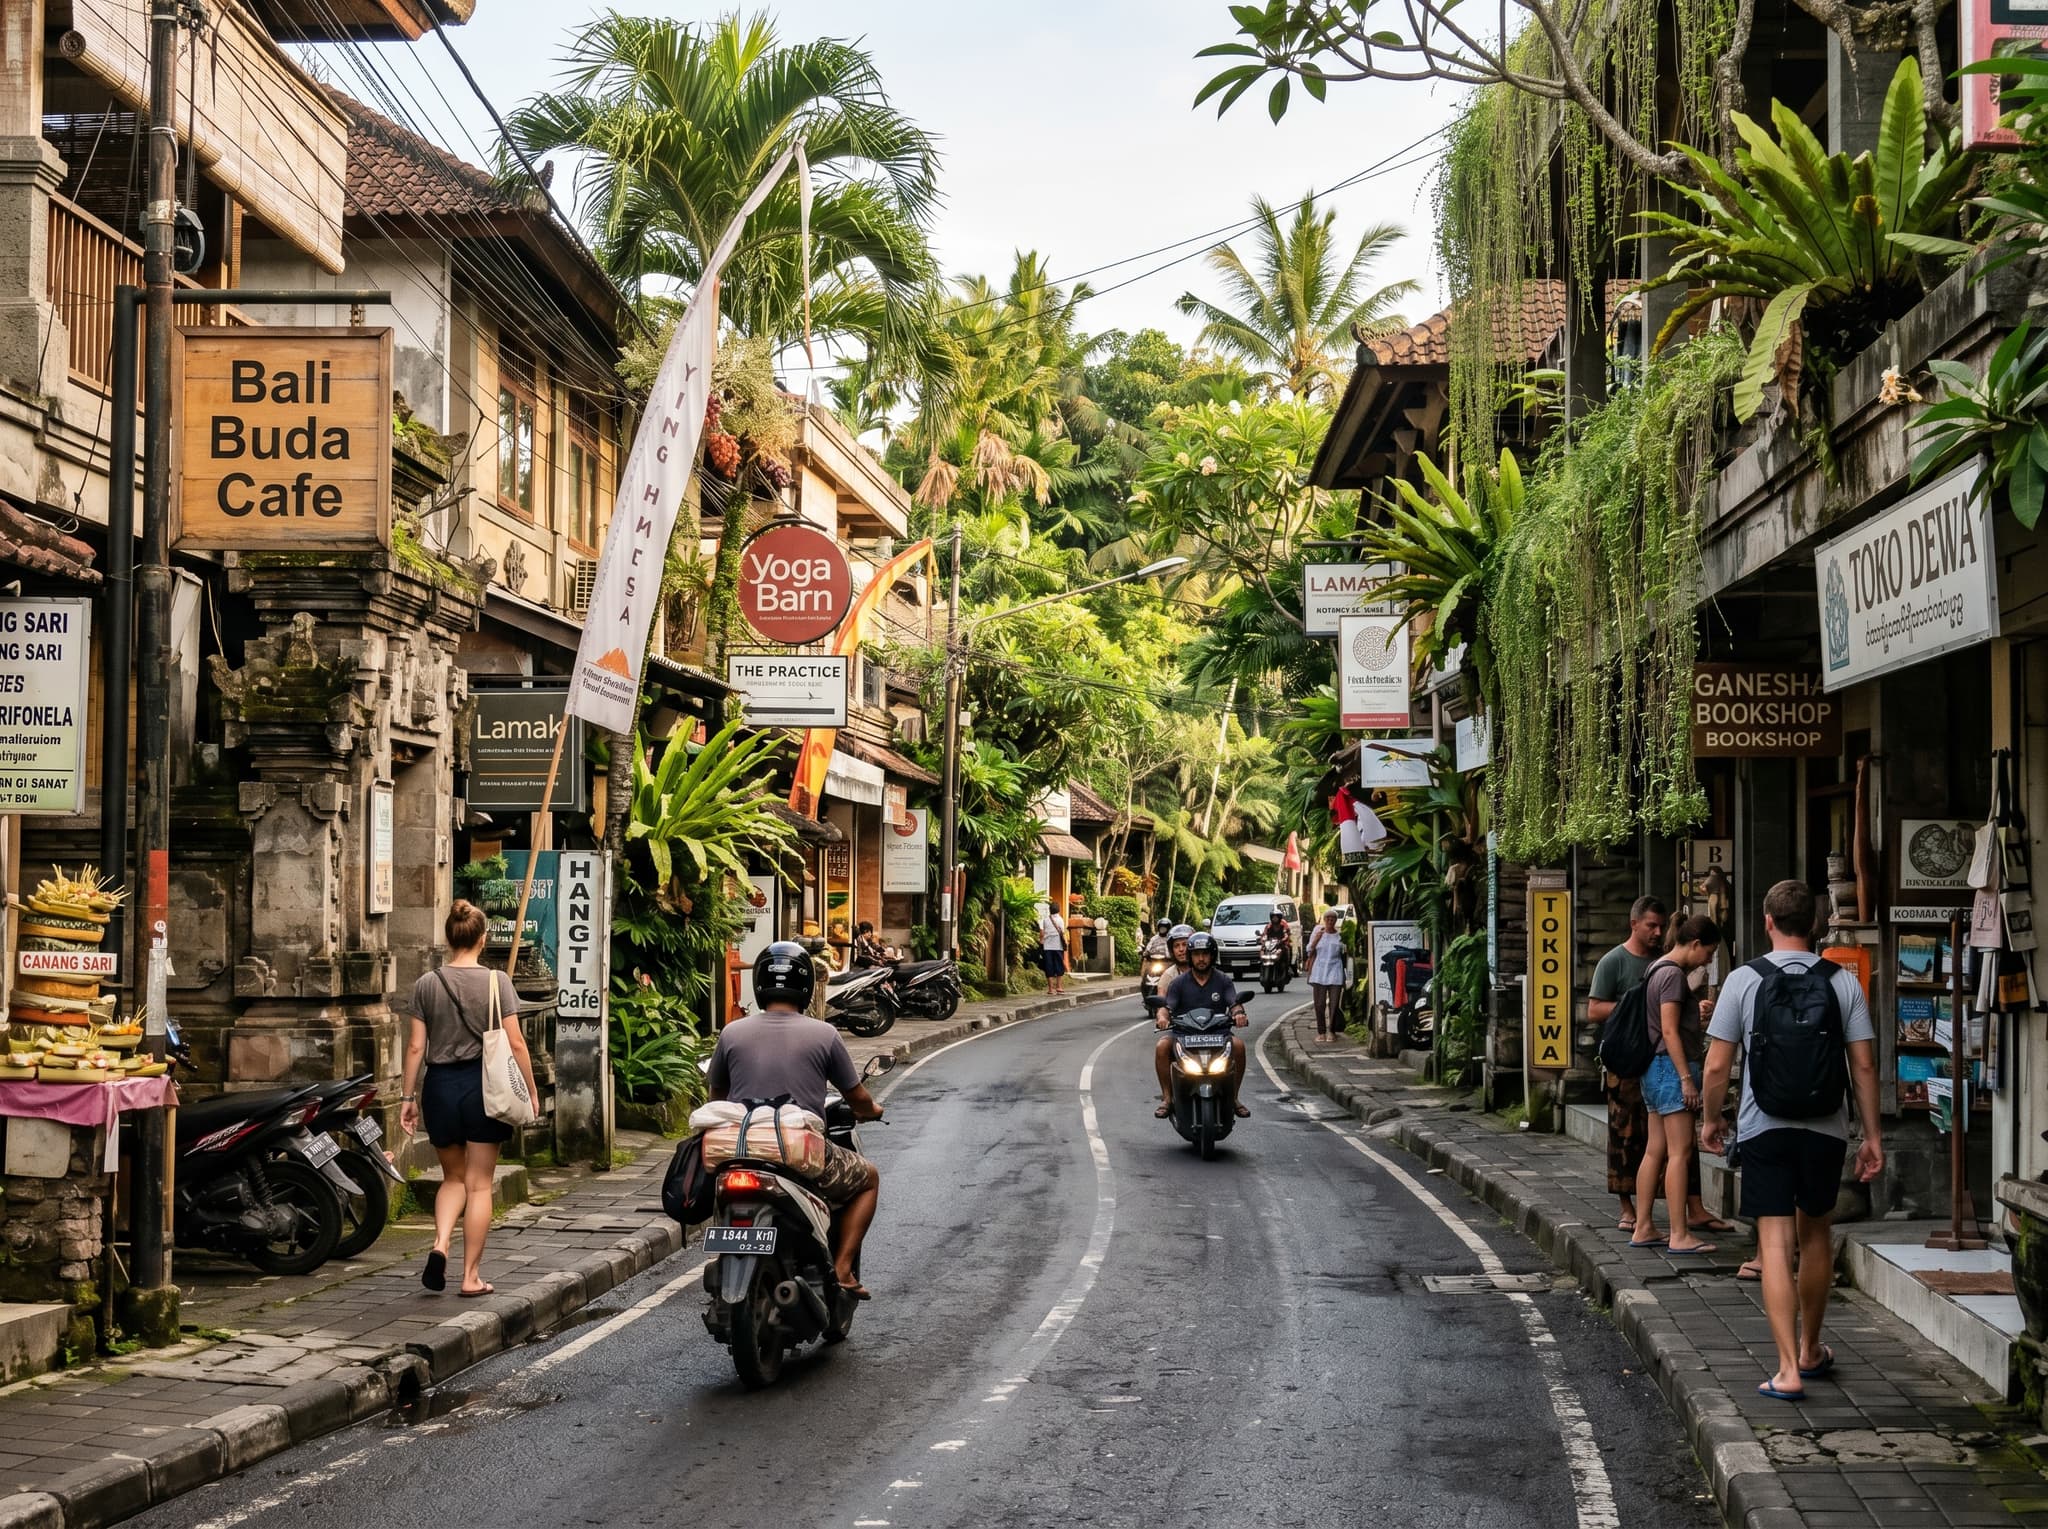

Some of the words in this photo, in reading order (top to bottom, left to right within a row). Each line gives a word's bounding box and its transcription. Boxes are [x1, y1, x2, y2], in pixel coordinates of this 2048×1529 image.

[232, 360, 330, 404] Bali
[211, 415, 350, 460] Buda
[217, 472, 343, 517] Cafe
[1849, 529, 1902, 614] TOKO
[1908, 491, 1977, 590] DEWA
[749, 553, 831, 588] Yoga
[757, 583, 833, 612] Barn
[24, 612, 68, 634] SARI
[25, 643, 62, 661] SARI
[735, 665, 763, 677] THE
[769, 665, 841, 678] PRACTICE
[477, 714, 562, 739] Lamak
[1697, 703, 1831, 725] BOOKSHOP
[1706, 732, 1822, 747] BOOKSHOP
[31, 778, 68, 790] SANAT
[1708, 846, 1722, 863] B
[569, 861, 590, 985] HANGTL
[1541, 897, 1559, 974] TOKO
[23, 954, 78, 970] CANANG
[82, 956, 112, 971] SARI
[558, 988, 599, 1009] Café
[1538, 984, 1562, 1060] DEWA
